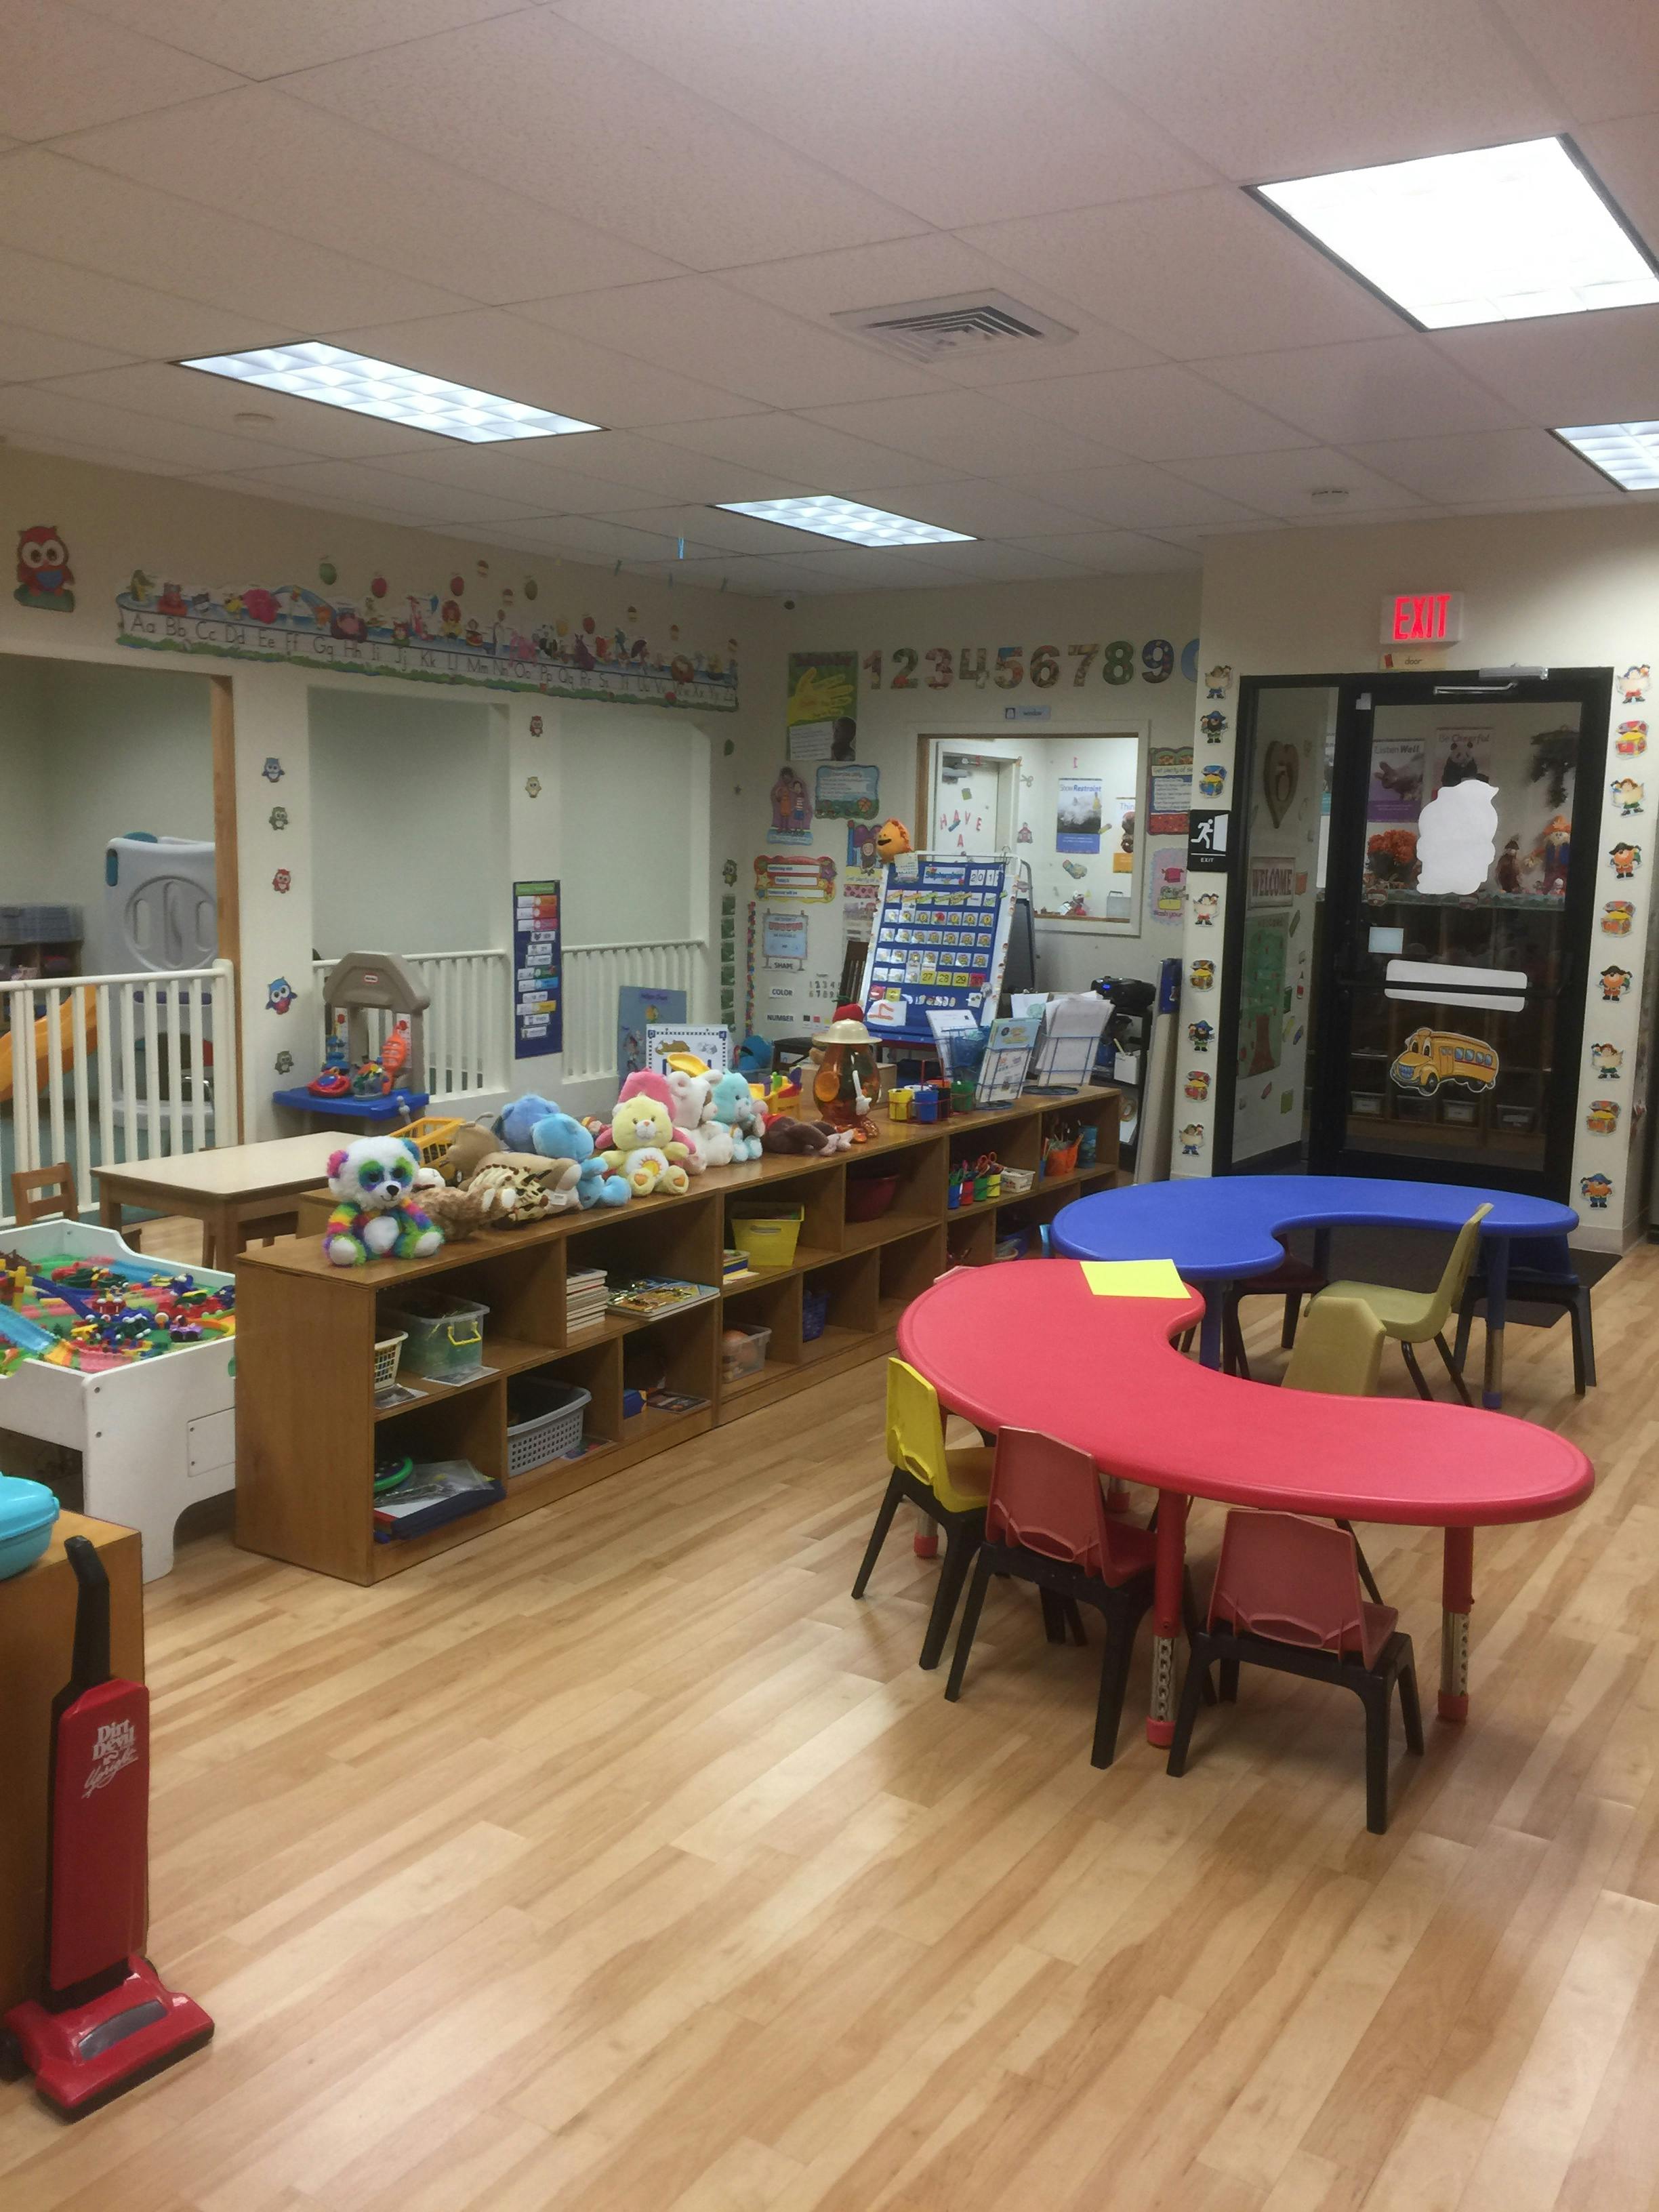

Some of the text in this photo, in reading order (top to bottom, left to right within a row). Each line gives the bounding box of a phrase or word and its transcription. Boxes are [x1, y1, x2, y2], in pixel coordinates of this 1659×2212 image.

[1393, 594, 1452, 640] EXIT
[131, 616, 155, 634] Aa
[166, 617, 186, 637] Bb
[196, 621, 216, 640] Cc
[225, 623, 245, 644] Dd
[259, 630, 274, 648] Ee
[314, 637, 333, 662] Gg
[422, 651, 436, 667] Kk
[468, 657, 488, 672] Mm
[515, 663, 532, 679] Oo
[863, 650, 882, 689] 1
[890, 648, 918, 689] 2
[925, 648, 952, 689] 3
[959, 648, 989, 689] 4
[994, 646, 1023, 689] 5
[1030, 644, 1060, 688] 6
[1067, 644, 1099, 687] 7
[1103, 640, 1134, 684] 8
[1142, 639, 1174, 683] 9
[1404, 657, 1422, 665] door
[1452, 733, 1490, 744] Cheerful
[1374, 745, 1420, 754] Listen Well
[970, 873, 999, 883] 201
[1252, 868, 1292, 897] WELCOME
[774, 961, 794, 970] SHAPE
[956, 976, 966, 984] 29
[767, 1014, 794, 1023] NUMBER
[98, 1719, 130, 1743] Dirt
[92, 1725, 136, 1761] Devil
[81, 1748, 139, 1799] Upright
